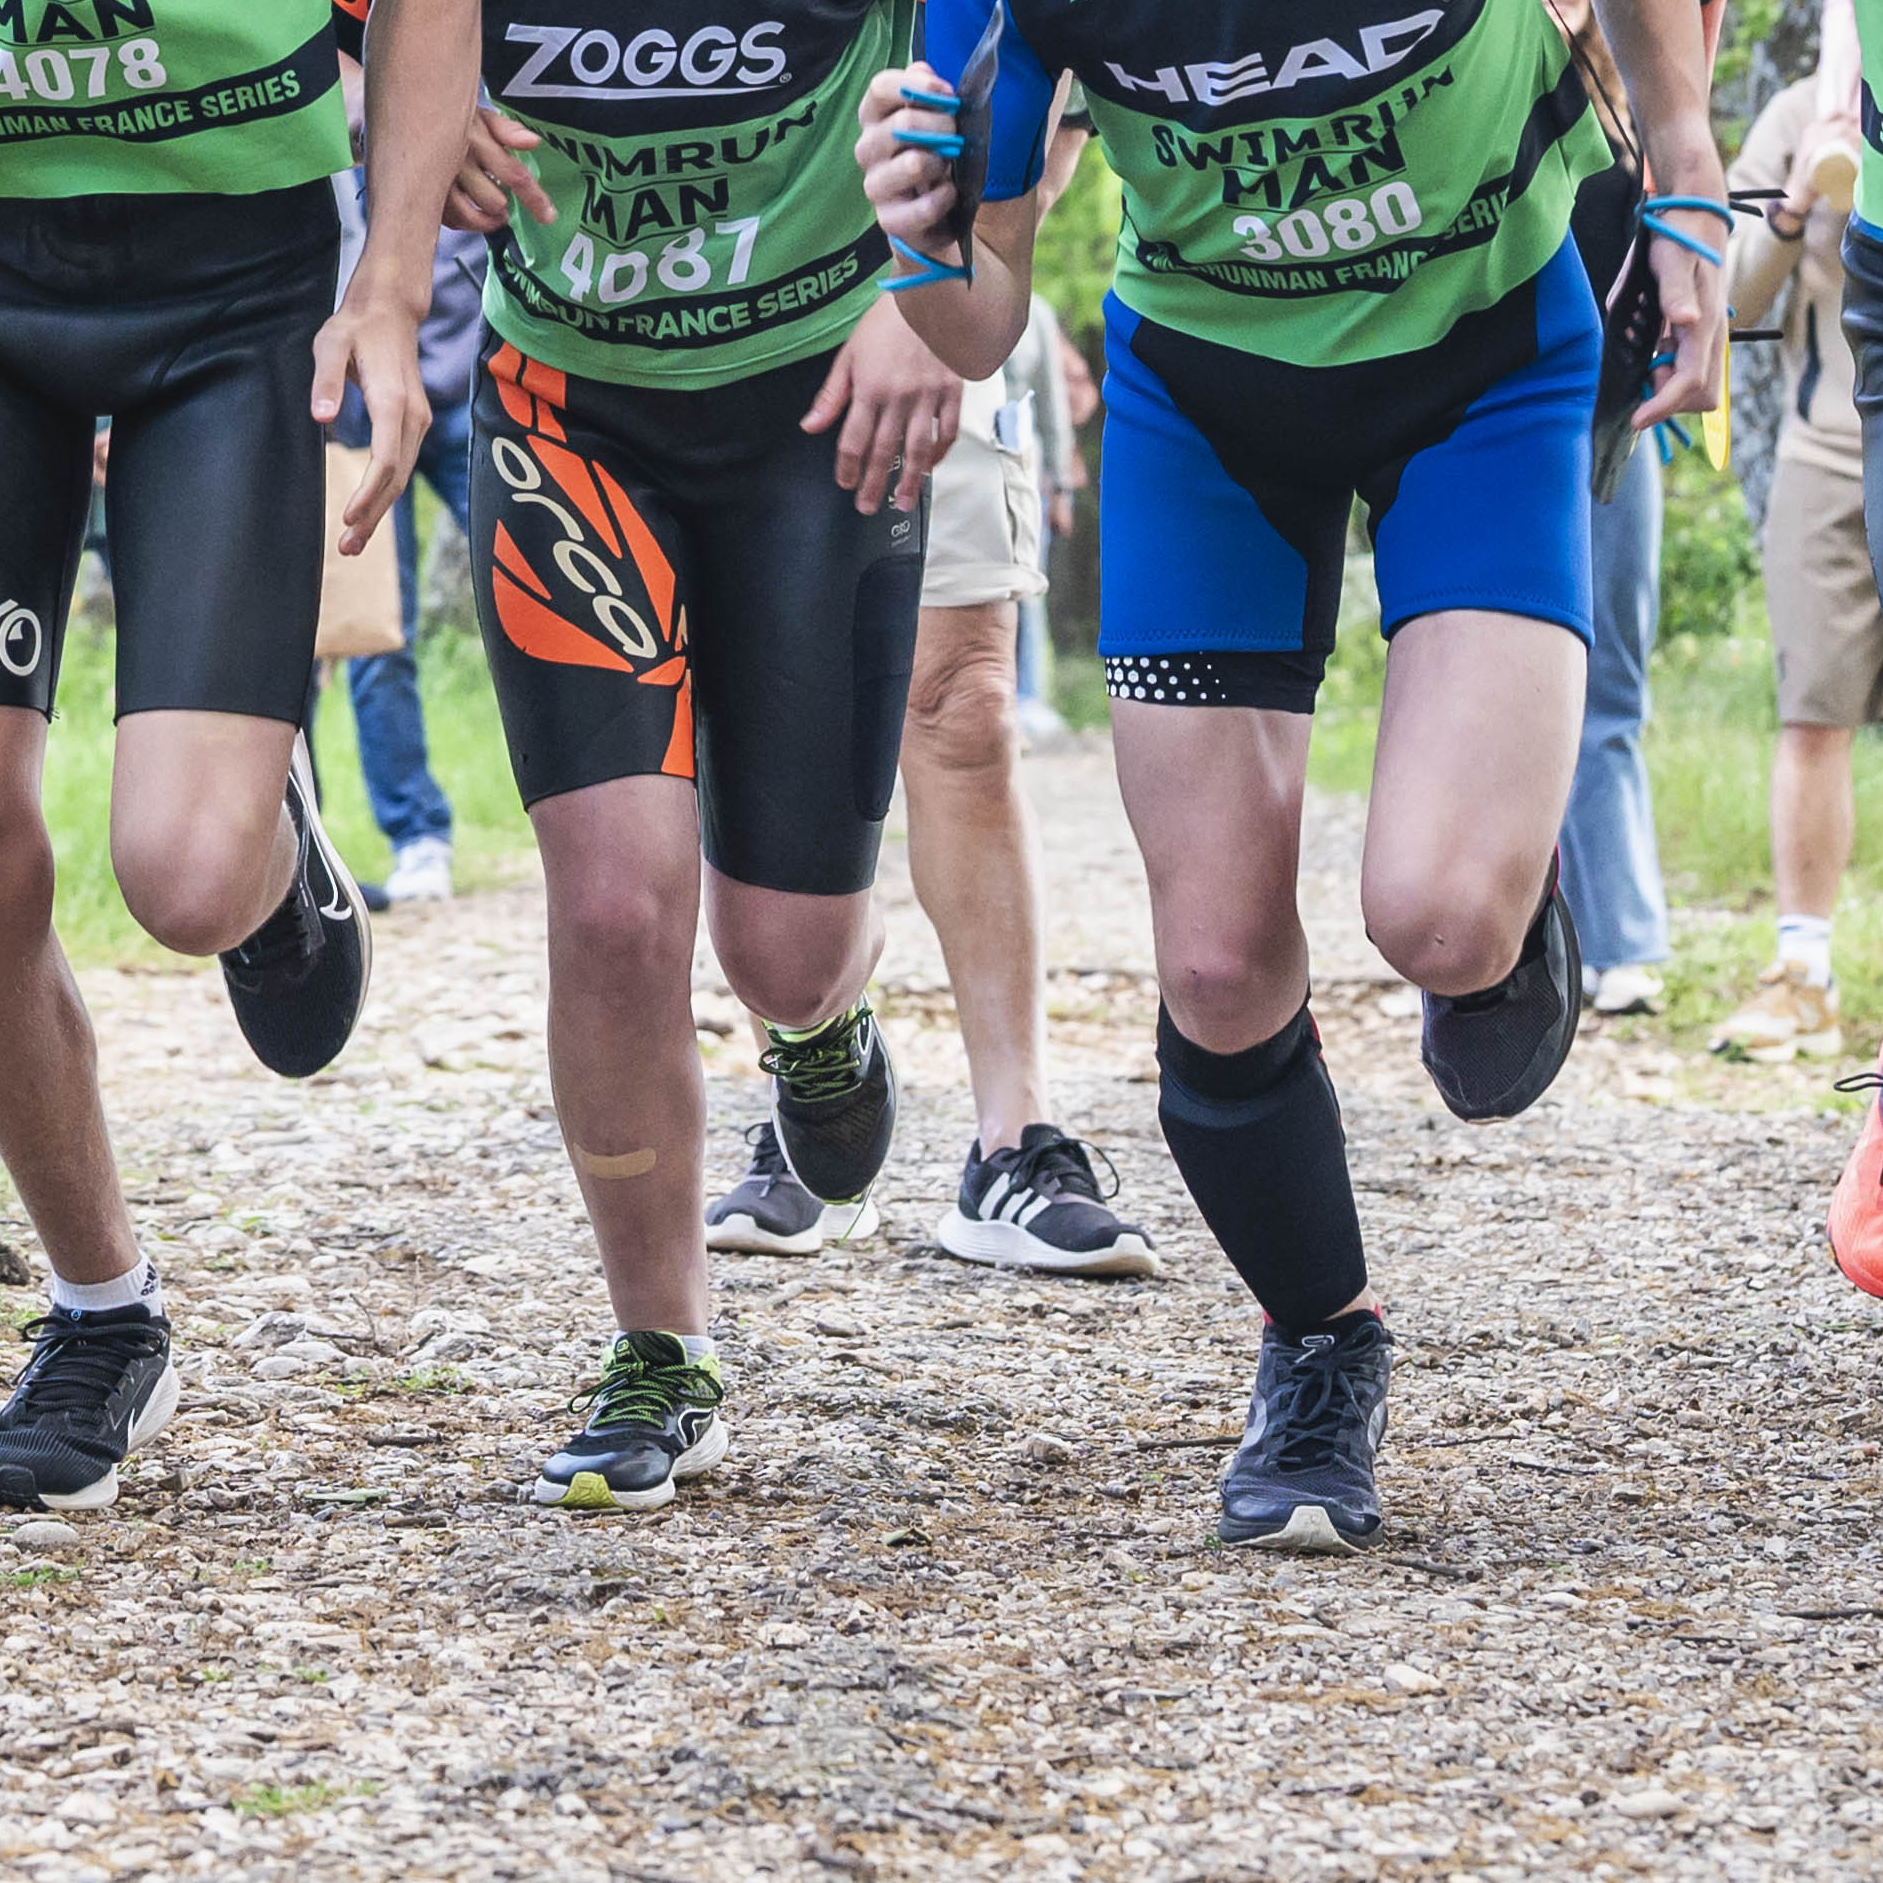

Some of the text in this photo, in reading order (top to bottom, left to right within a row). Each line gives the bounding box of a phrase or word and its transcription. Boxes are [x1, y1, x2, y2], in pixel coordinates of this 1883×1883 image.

[501, 21, 787, 100] ZOGGS
[1104, 9, 1445, 107] HEAD
[77, 100, 194, 136] FRANCE
[201, 69, 302, 119] SERIES
[581, 173, 730, 243] MAN
[1222, 127, 1407, 210] MAN
[560, 216, 761, 304] 4087
[1232, 181, 1423, 262] 3080
[617, 303, 751, 340] FRANCE
[756, 251, 859, 311] SERIES
[491, 436, 658, 659] orca
